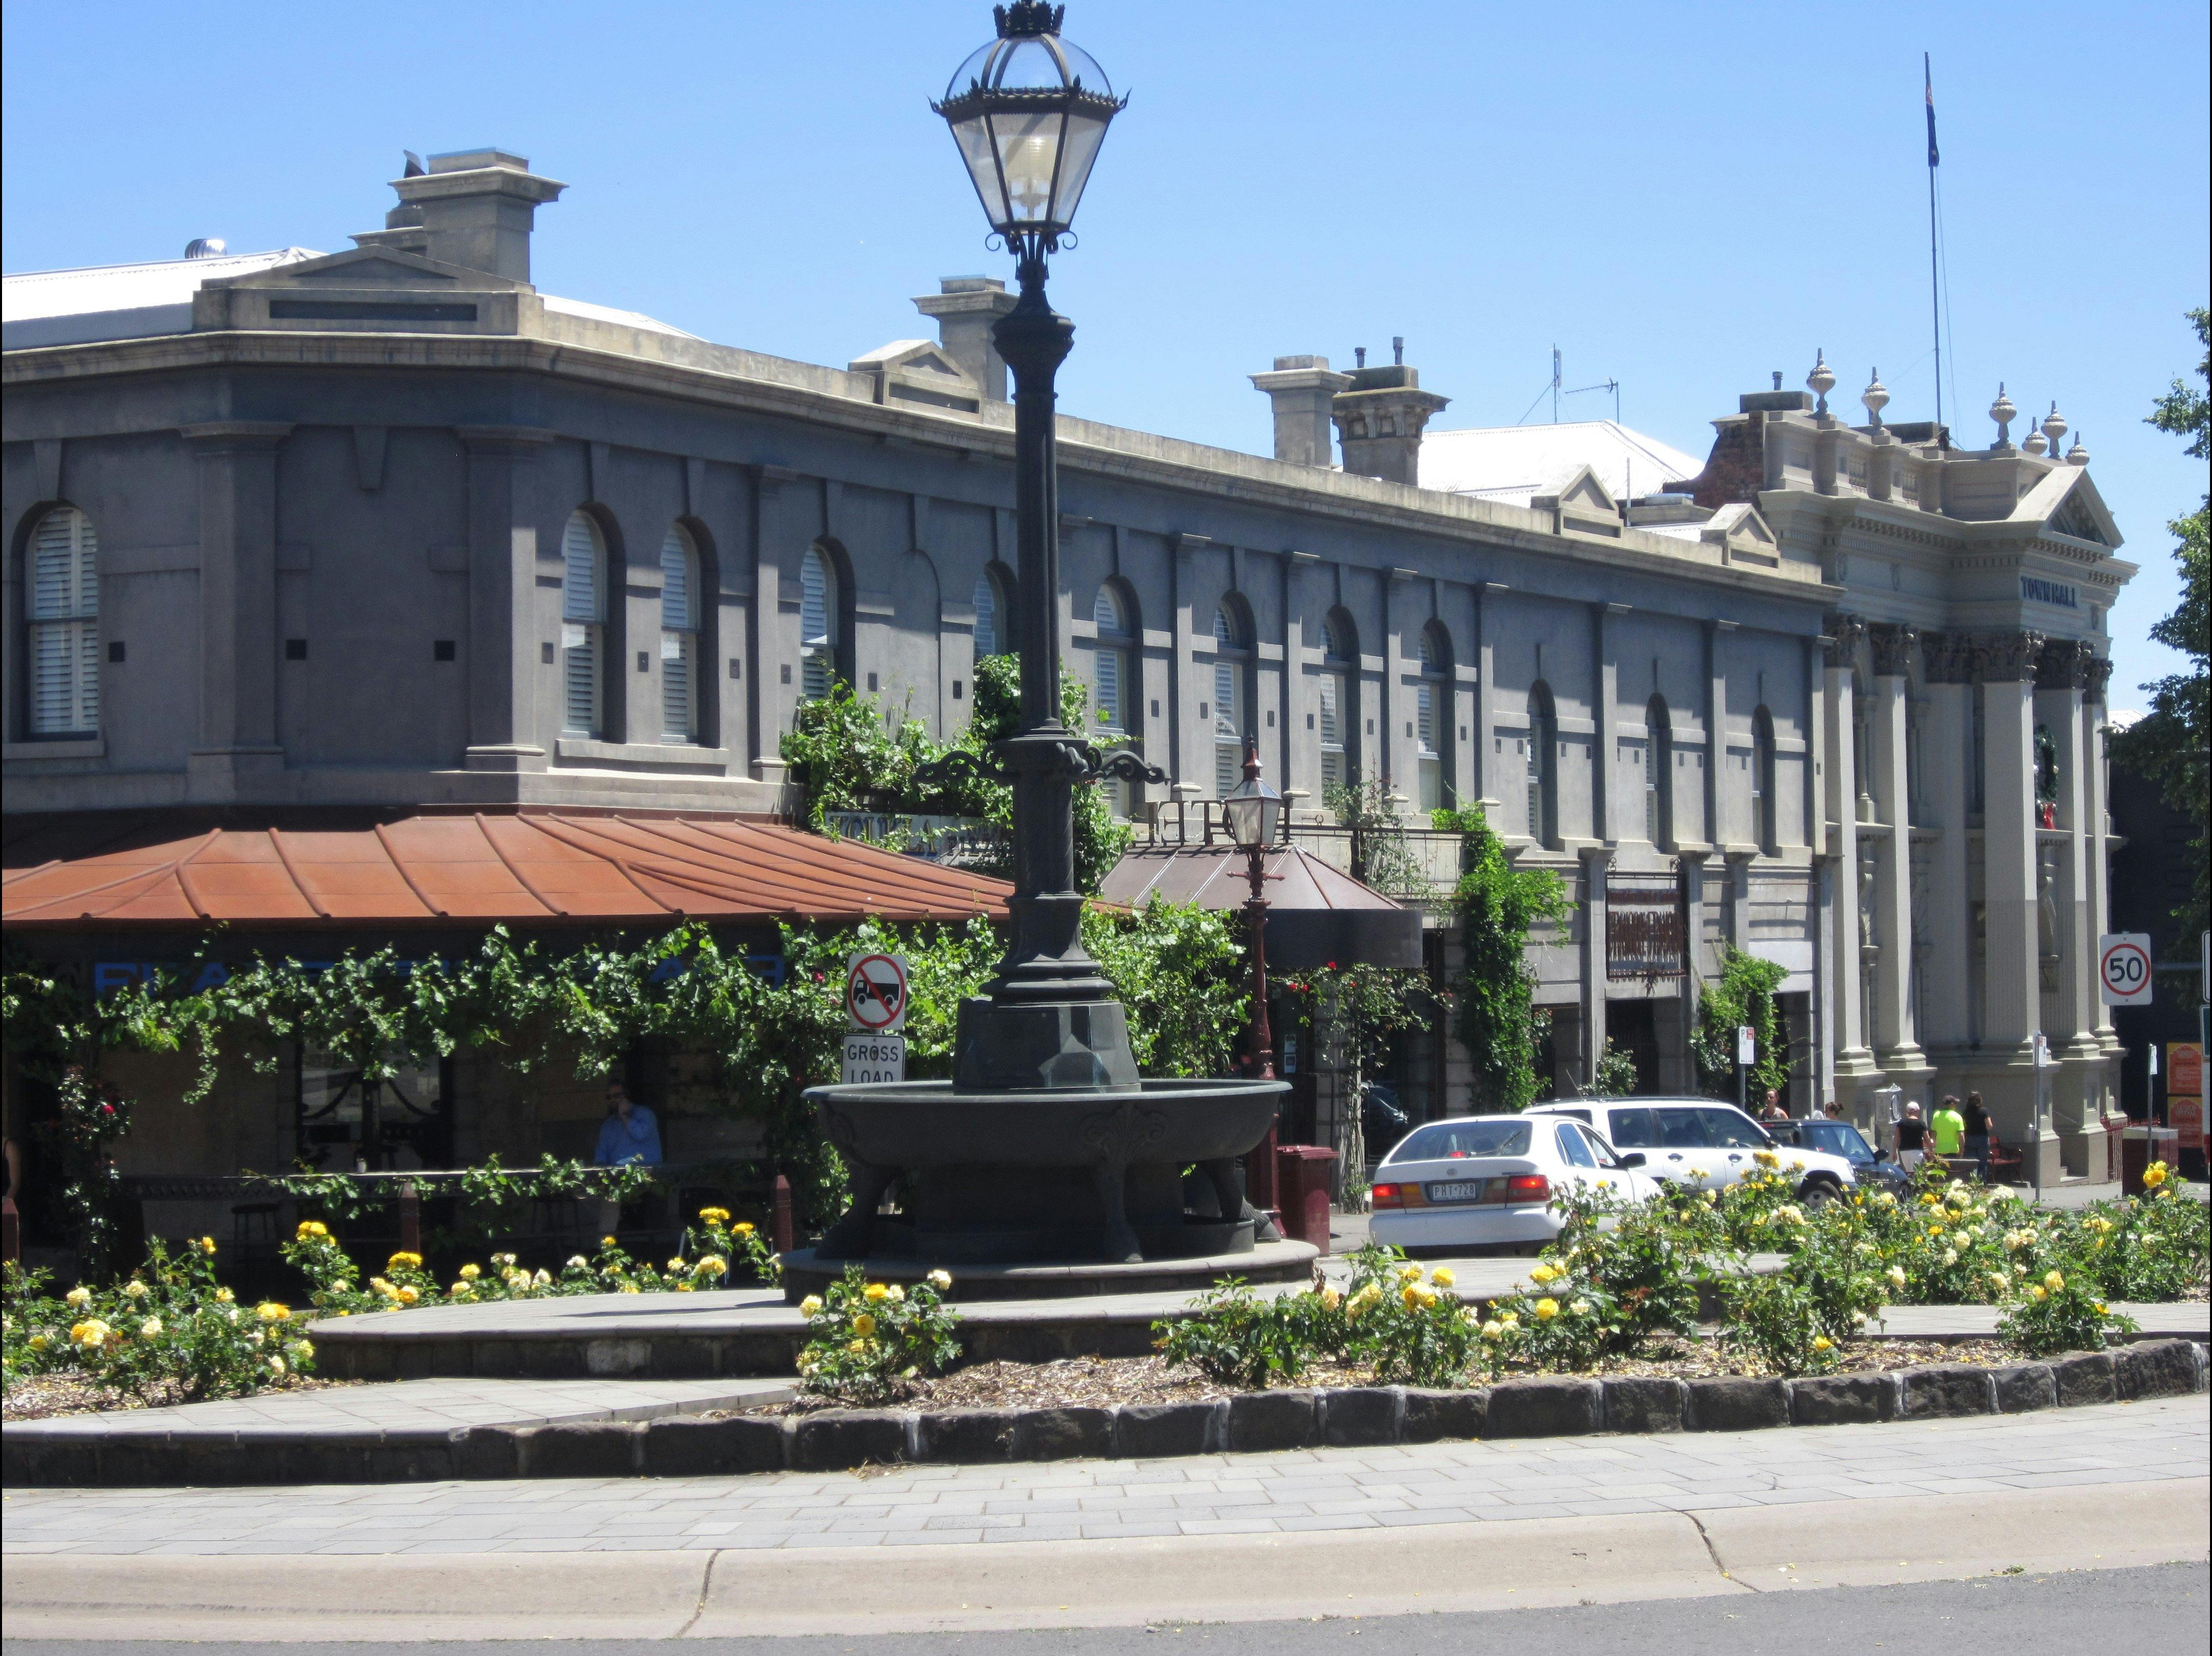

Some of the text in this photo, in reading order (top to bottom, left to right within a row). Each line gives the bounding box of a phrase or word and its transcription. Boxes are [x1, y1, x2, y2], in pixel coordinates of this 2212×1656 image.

[2020, 576, 2078, 608] TOWN HALL
[2110, 957, 2142, 983] 50
[847, 1044, 898, 1062] GROSS
